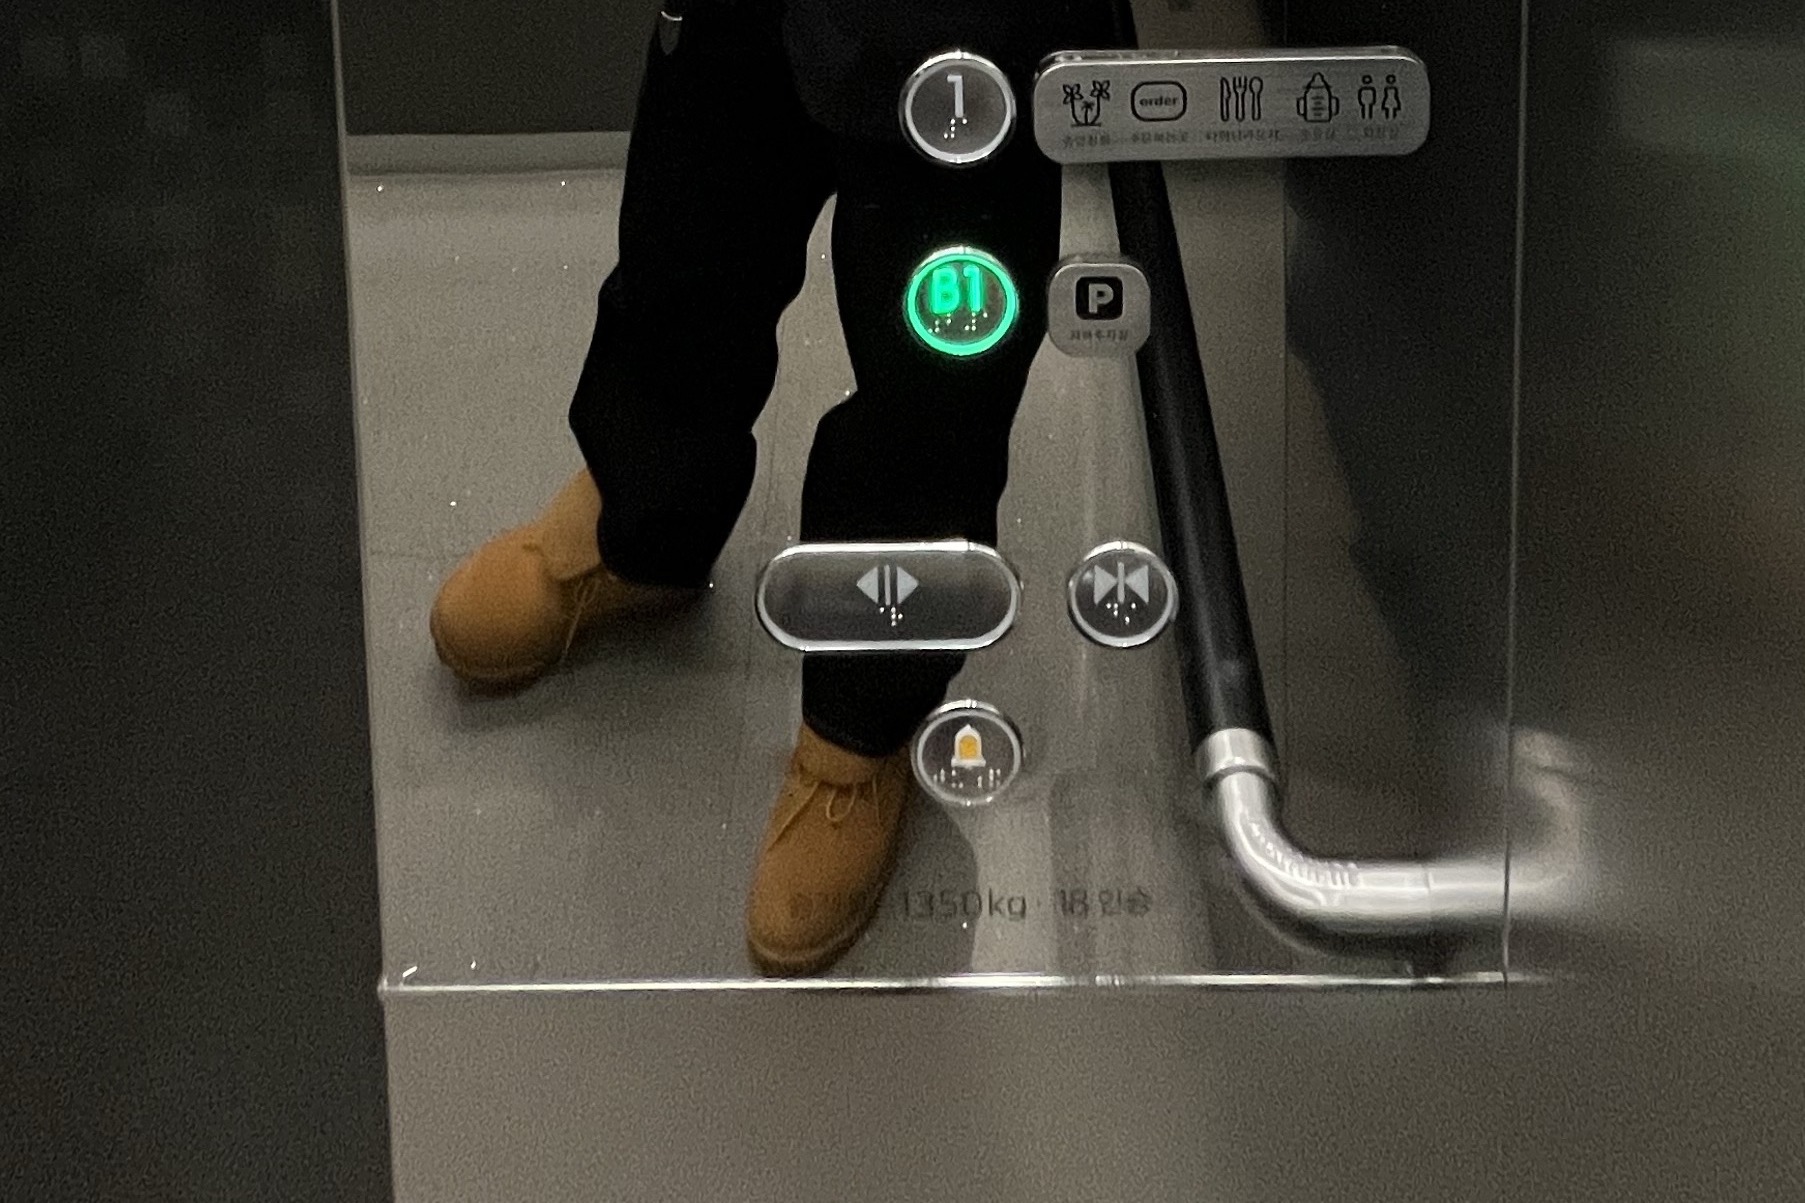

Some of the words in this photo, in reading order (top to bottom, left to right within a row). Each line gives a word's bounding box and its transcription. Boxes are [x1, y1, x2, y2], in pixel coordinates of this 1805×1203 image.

[947, 75, 964, 118] 1
[1139, 95, 1178, 107] order
[931, 265, 984, 315] B1
[1088, 282, 1114, 314] P
